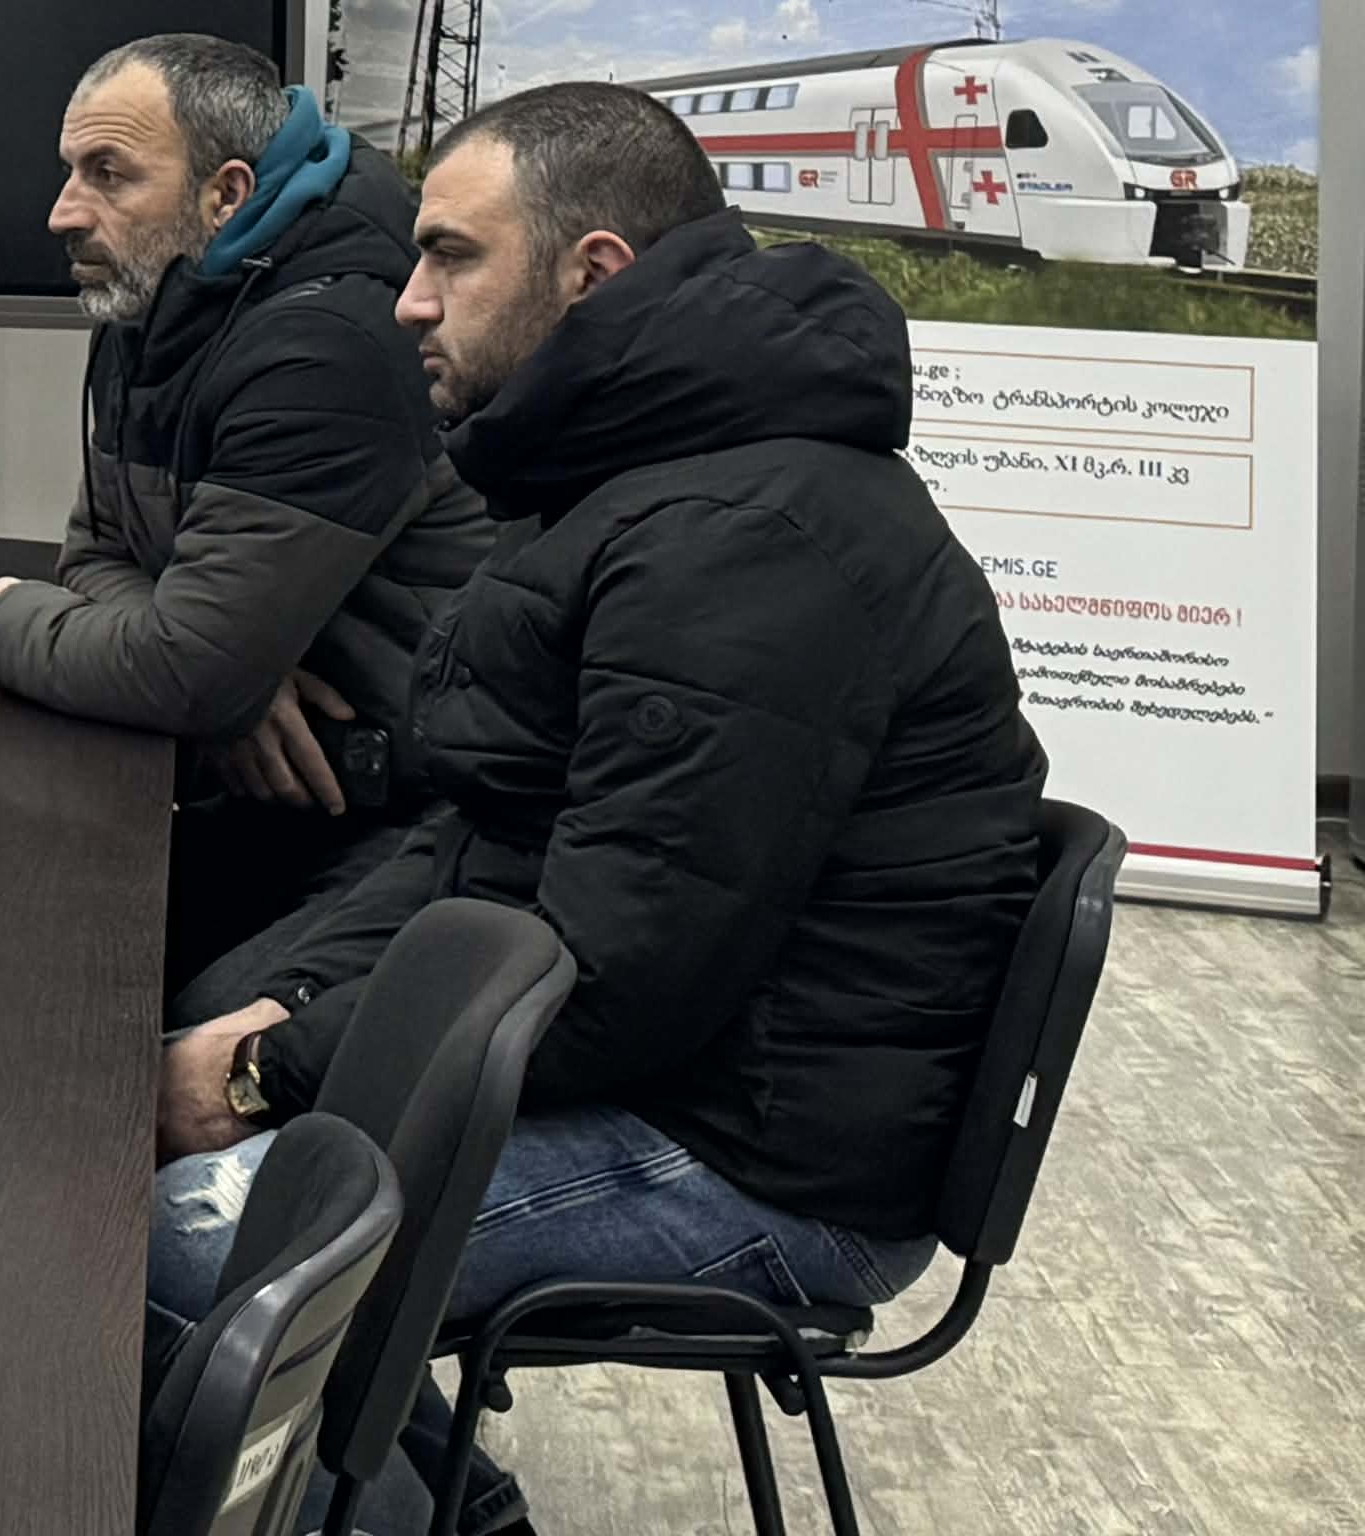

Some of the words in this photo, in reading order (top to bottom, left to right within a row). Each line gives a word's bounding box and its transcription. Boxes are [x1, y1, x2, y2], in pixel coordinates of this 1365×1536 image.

[992, 389, 1137, 416] ტრანსპორტის
[1142, 400, 1229, 423] კოლეჯი
[1139, 459, 1162, 477] III
[1019, 592, 1172, 622] სახელმწიფოს
[1177, 604, 1231, 627] მიერ
